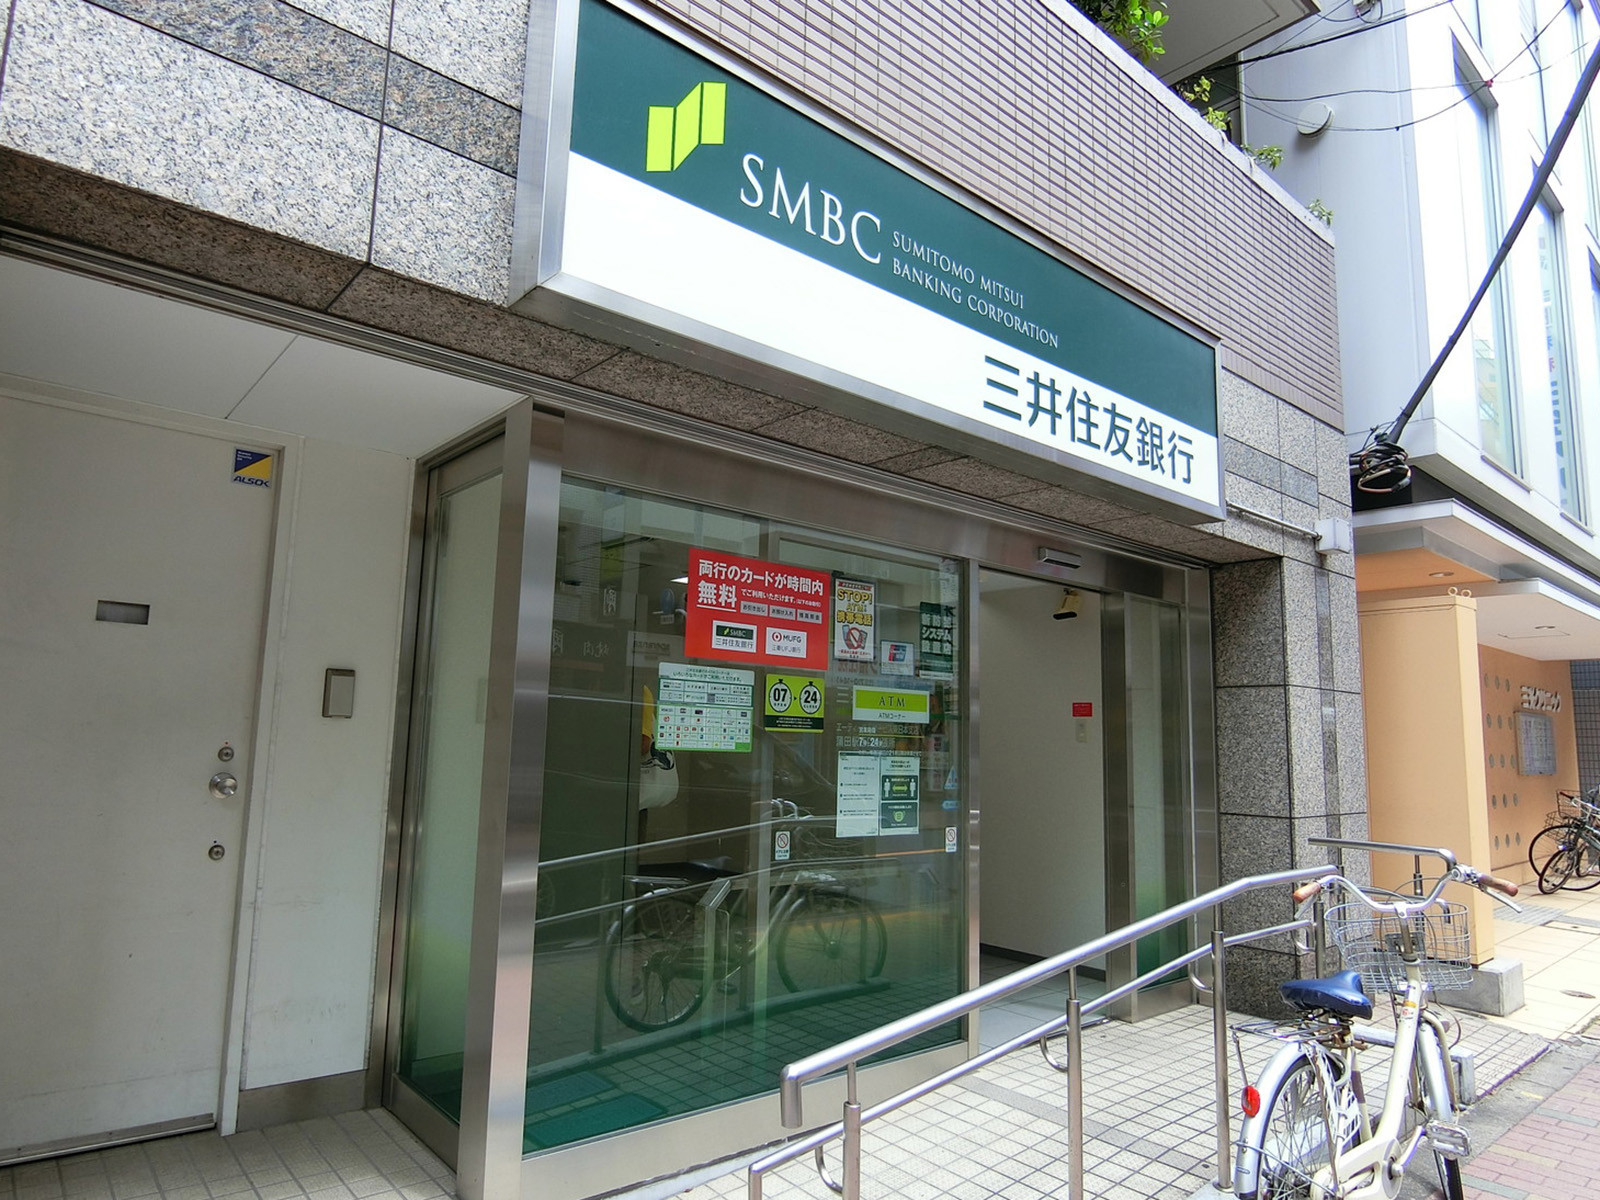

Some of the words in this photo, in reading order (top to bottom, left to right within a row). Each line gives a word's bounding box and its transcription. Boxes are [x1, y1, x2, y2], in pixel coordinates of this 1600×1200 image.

[740, 153, 881, 264] SMBC
[892, 231, 974, 284] SUMITOMO
[980, 276, 1024, 309] MITSUI
[892, 258, 962, 304] BANKING
[968, 295, 1058, 348] CORPORATION
[983, 354, 1194, 484] 三井住友銀行
[233, 475, 270, 488] ALSOK
[698, 559, 824, 596] 両行のカードが時間内
[697, 580, 738, 608] 無料
[838, 589, 872, 605] STOP!
[729, 628, 746, 637] SMBC
[782, 634, 802, 643] MUFG
[920, 626, 953, 641] システム
[715, 637, 754, 650] 三井住友銀行
[773, 687, 788, 702] 07
[803, 690, 818, 704] 24
[878, 696, 906, 707] ATM
